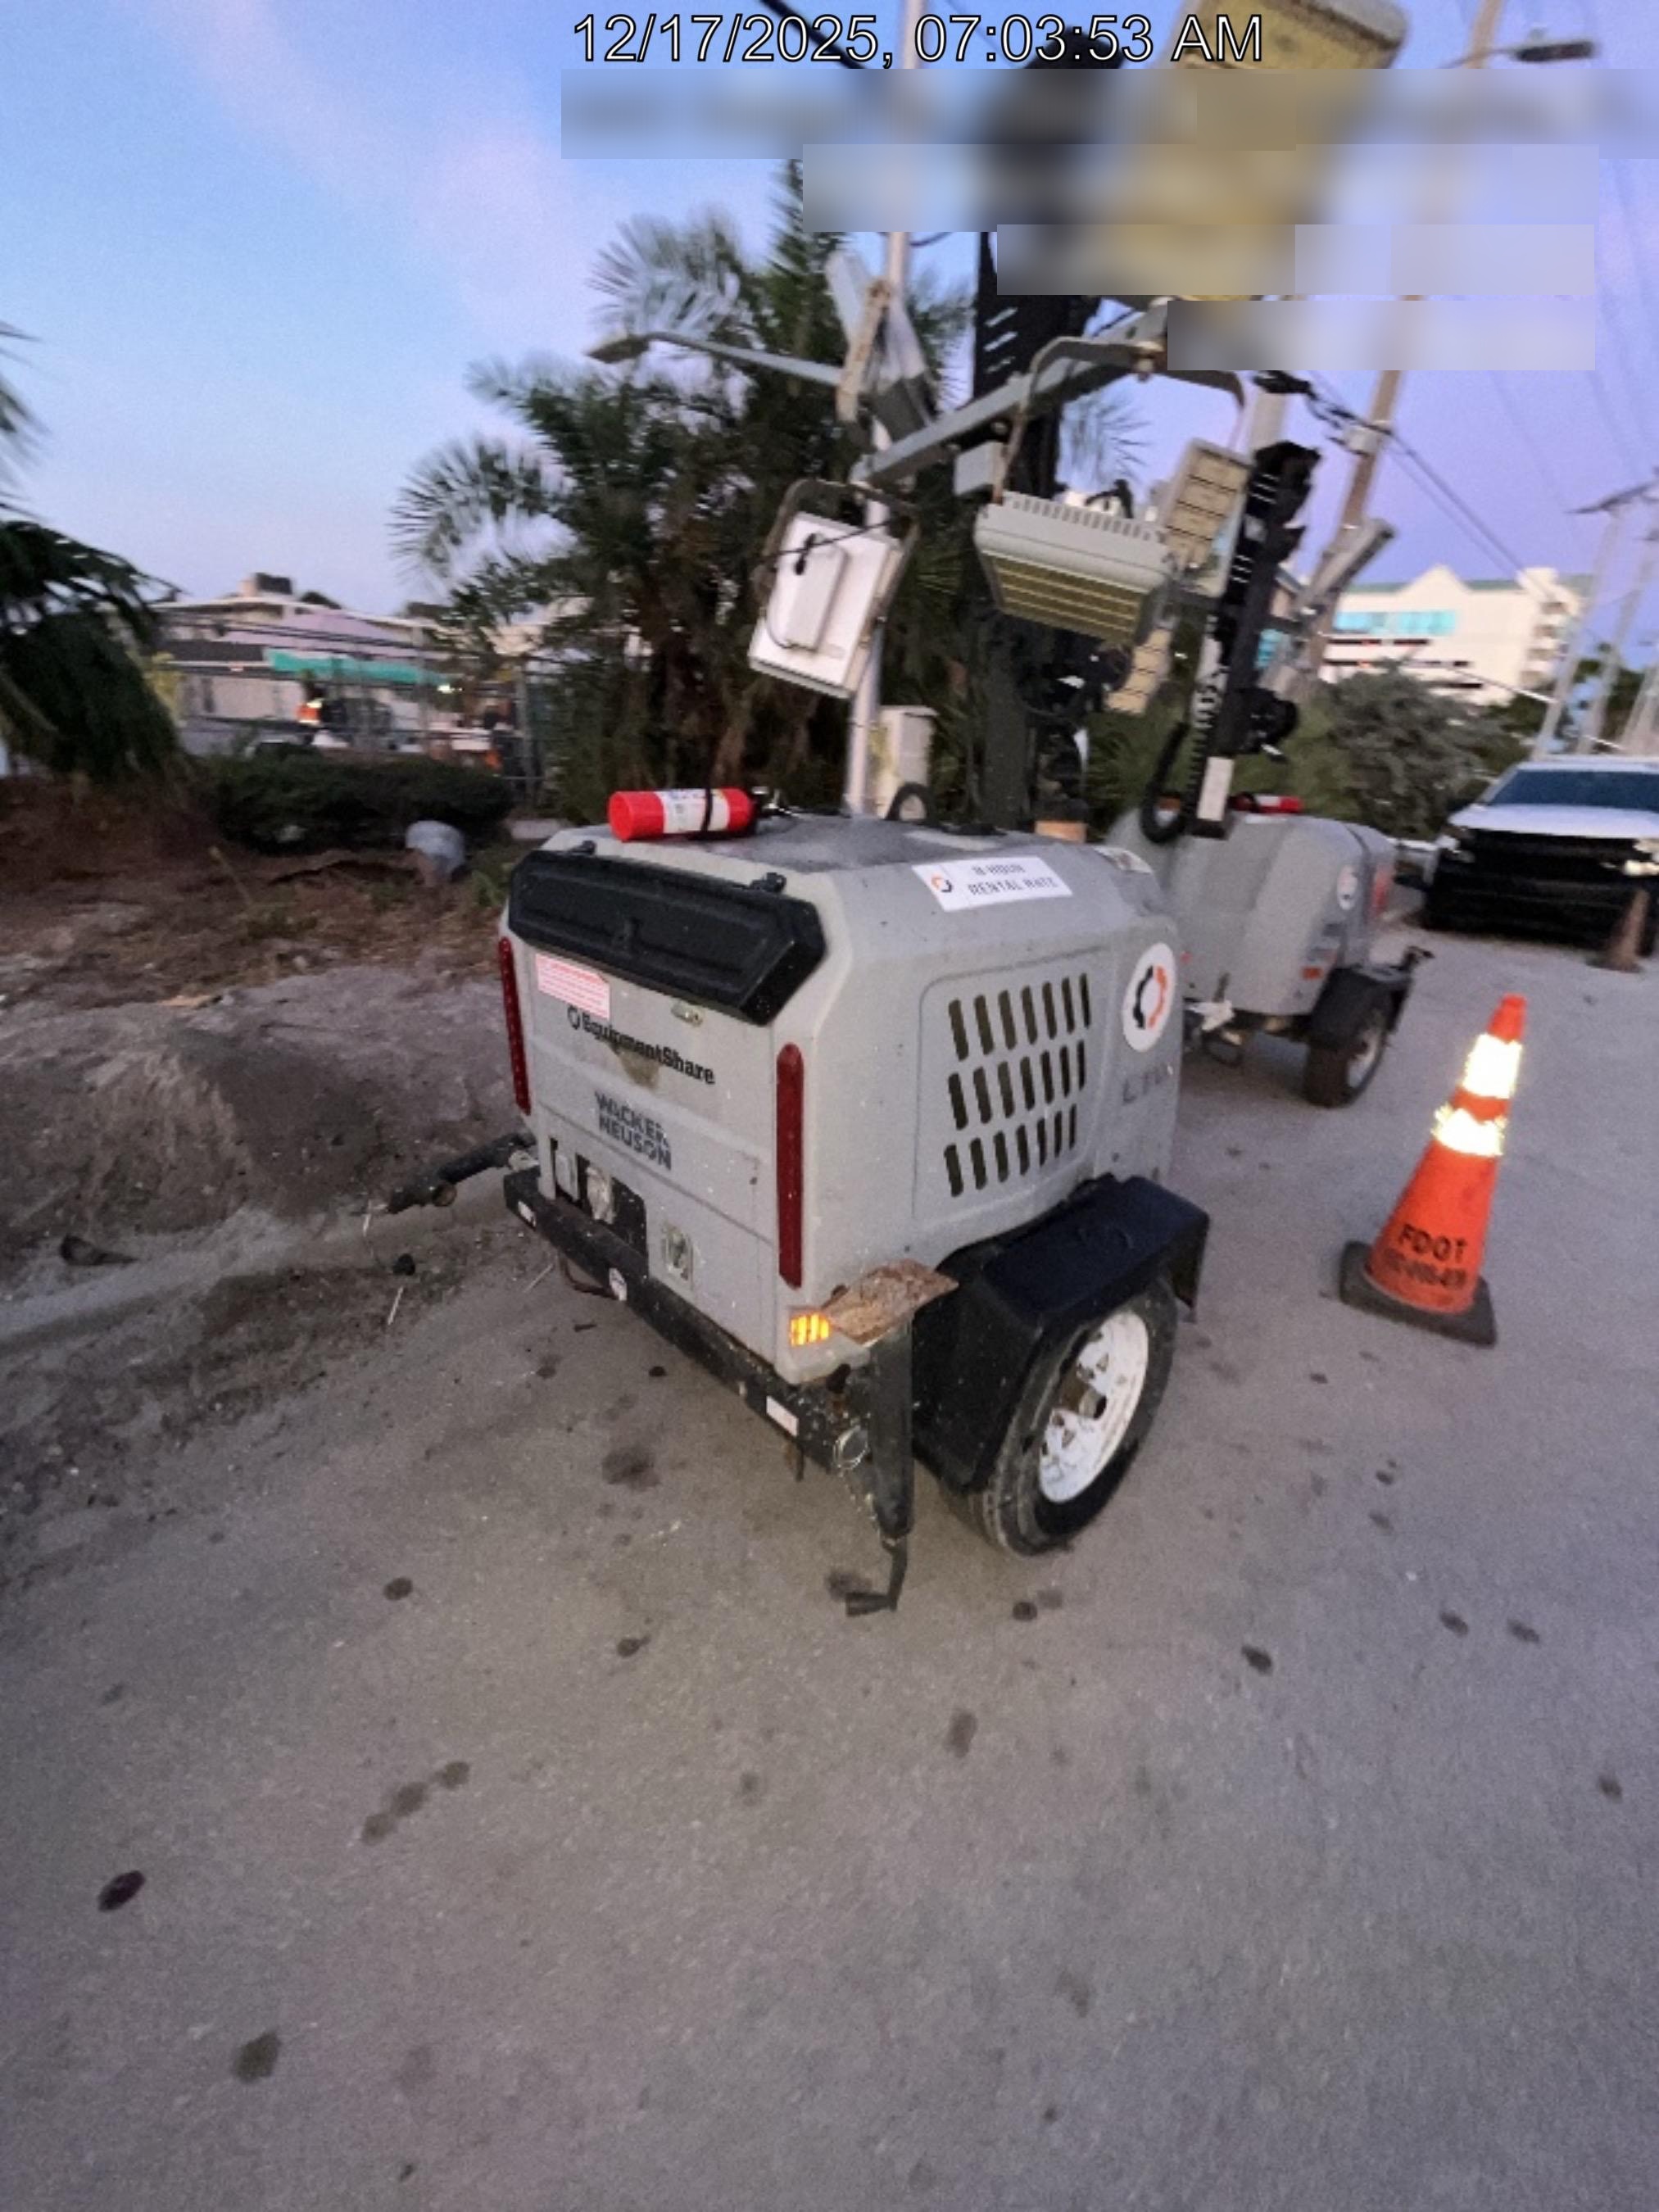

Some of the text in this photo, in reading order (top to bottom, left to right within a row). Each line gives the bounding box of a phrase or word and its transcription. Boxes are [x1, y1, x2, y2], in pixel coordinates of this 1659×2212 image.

[582, 1009, 715, 1085] EquipmentShare
[595, 1090, 669, 1148] WACKER
[600, 1113, 672, 1171] NEUSON
[1398, 1223, 1467, 1263] FOOT
